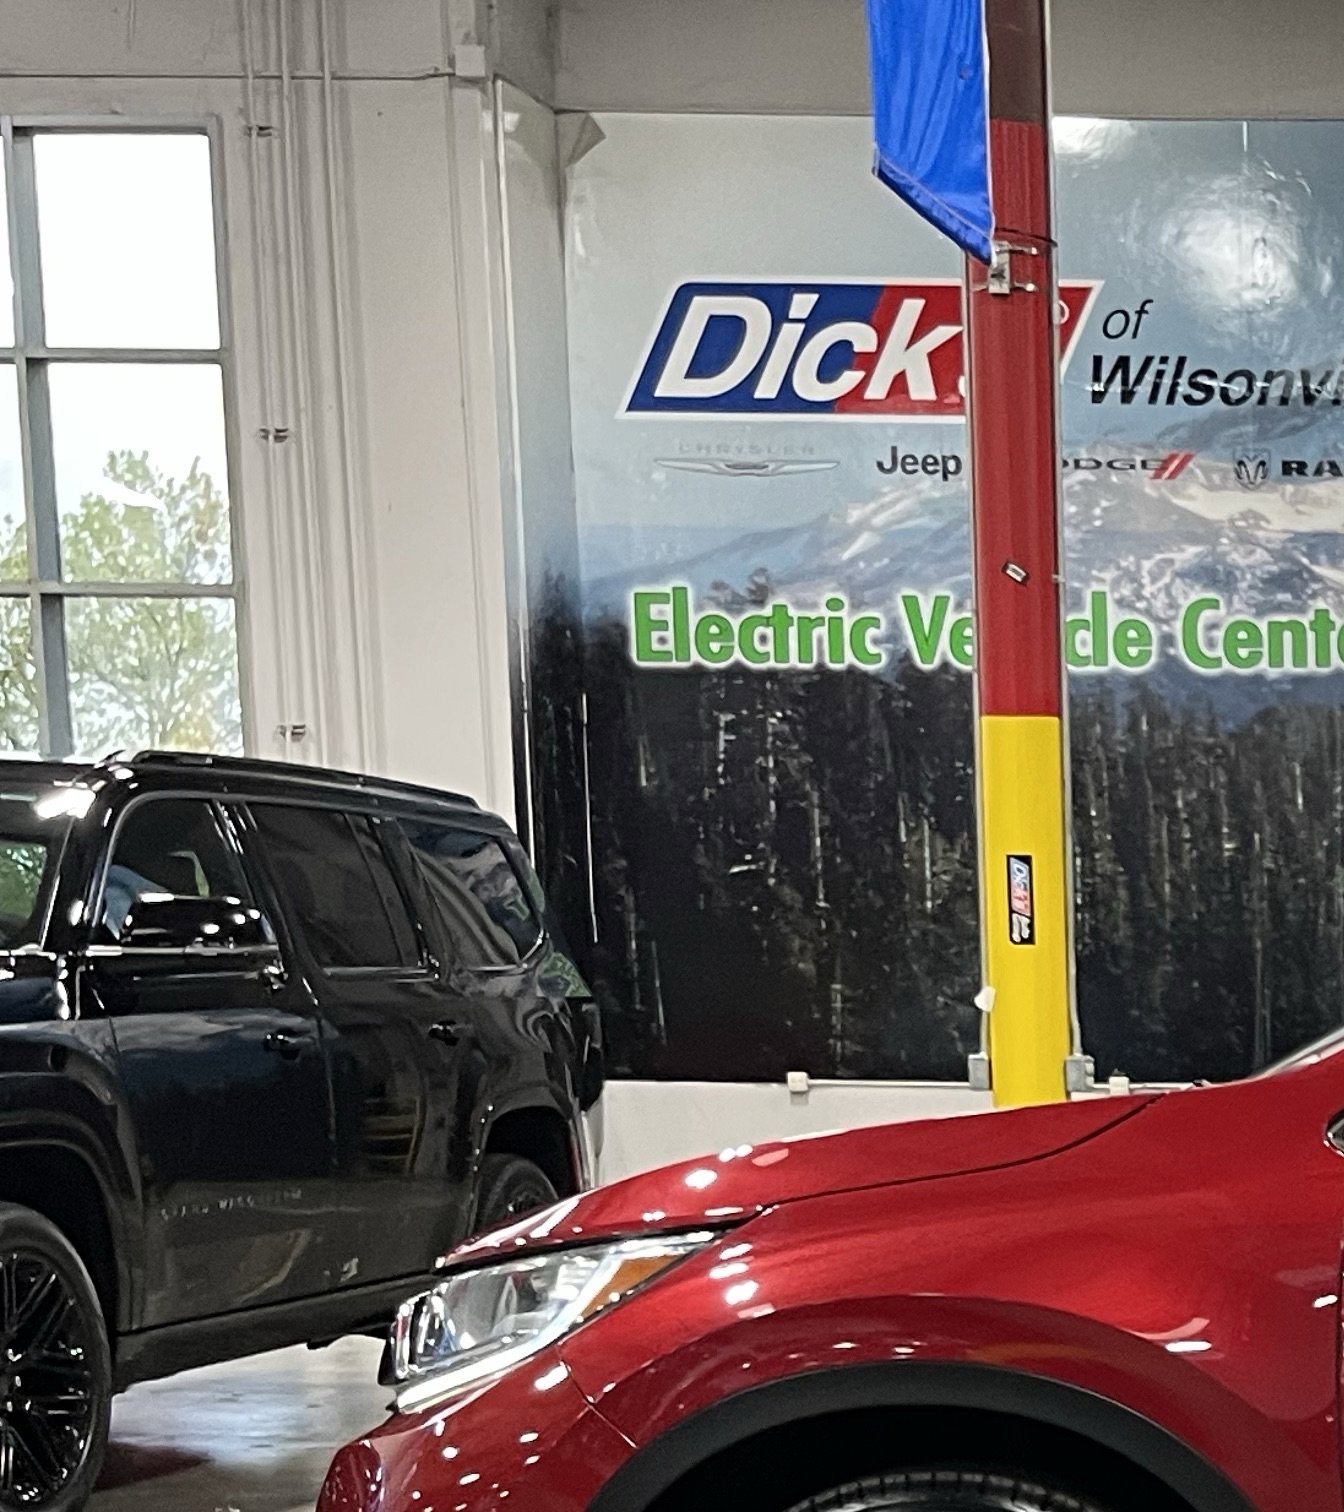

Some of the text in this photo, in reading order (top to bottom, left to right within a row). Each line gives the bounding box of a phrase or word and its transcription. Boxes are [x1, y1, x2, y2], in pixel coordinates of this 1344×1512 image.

[1102, 299, 1154, 340] of
[653, 292, 967, 403] Dick
[876, 445, 963, 481] Jeep
[1063, 458, 1169, 471] DGE
[633, 586, 883, 664] Electric
[901, 590, 1153, 668] Vecle
